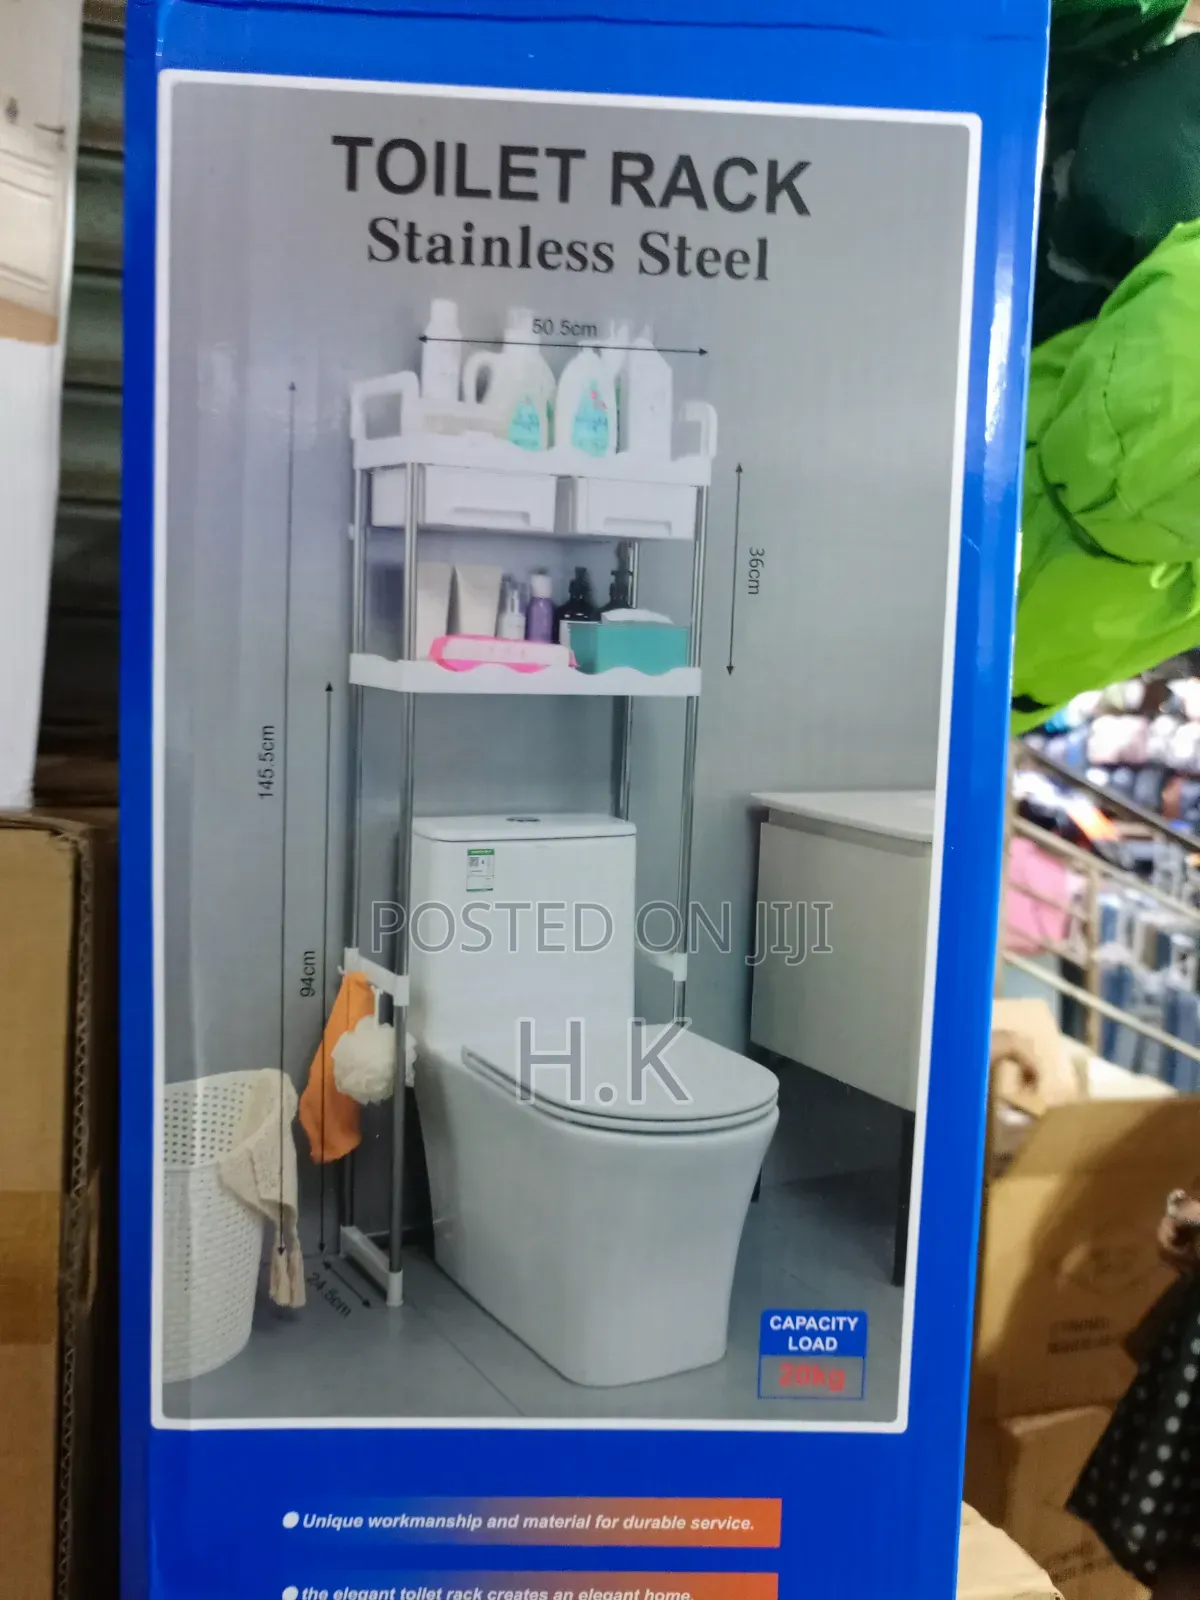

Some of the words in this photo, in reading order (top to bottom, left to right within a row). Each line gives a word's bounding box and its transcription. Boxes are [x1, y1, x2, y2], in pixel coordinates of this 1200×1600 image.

[332, 134, 587, 204] TOILET
[610, 150, 812, 217] RACK
[367, 216, 615, 274] Stainless
[638, 230, 769, 281] Steel
[748, 546, 765, 595] 36cm
[257, 724, 275, 800] 145.5cm
[299, 949, 316, 998] 94cm
[769, 1314, 859, 1332] CAPACITY
[788, 1335, 838, 1352] LOAD
[778, 1362, 846, 1392] 20kg
[302, 1513, 363, 1531] Unique
[368, 1513, 482, 1531] workmanship
[486, 1514, 519, 1529] and
[522, 1514, 592, 1530] material
[595, 1514, 620, 1529] for
[622, 1515, 686, 1530] durable
[690, 1515, 754, 1531] service.
[302, 1586, 328, 1600] the
[333, 1587, 396, 1600] elegant
[400, 1587, 443, 1600] toilet
[447, 1587, 483, 1600] rack
[487, 1589, 549, 1600] creates
[553, 1590, 574, 1600] an
[578, 1588, 640, 1600] elegant
